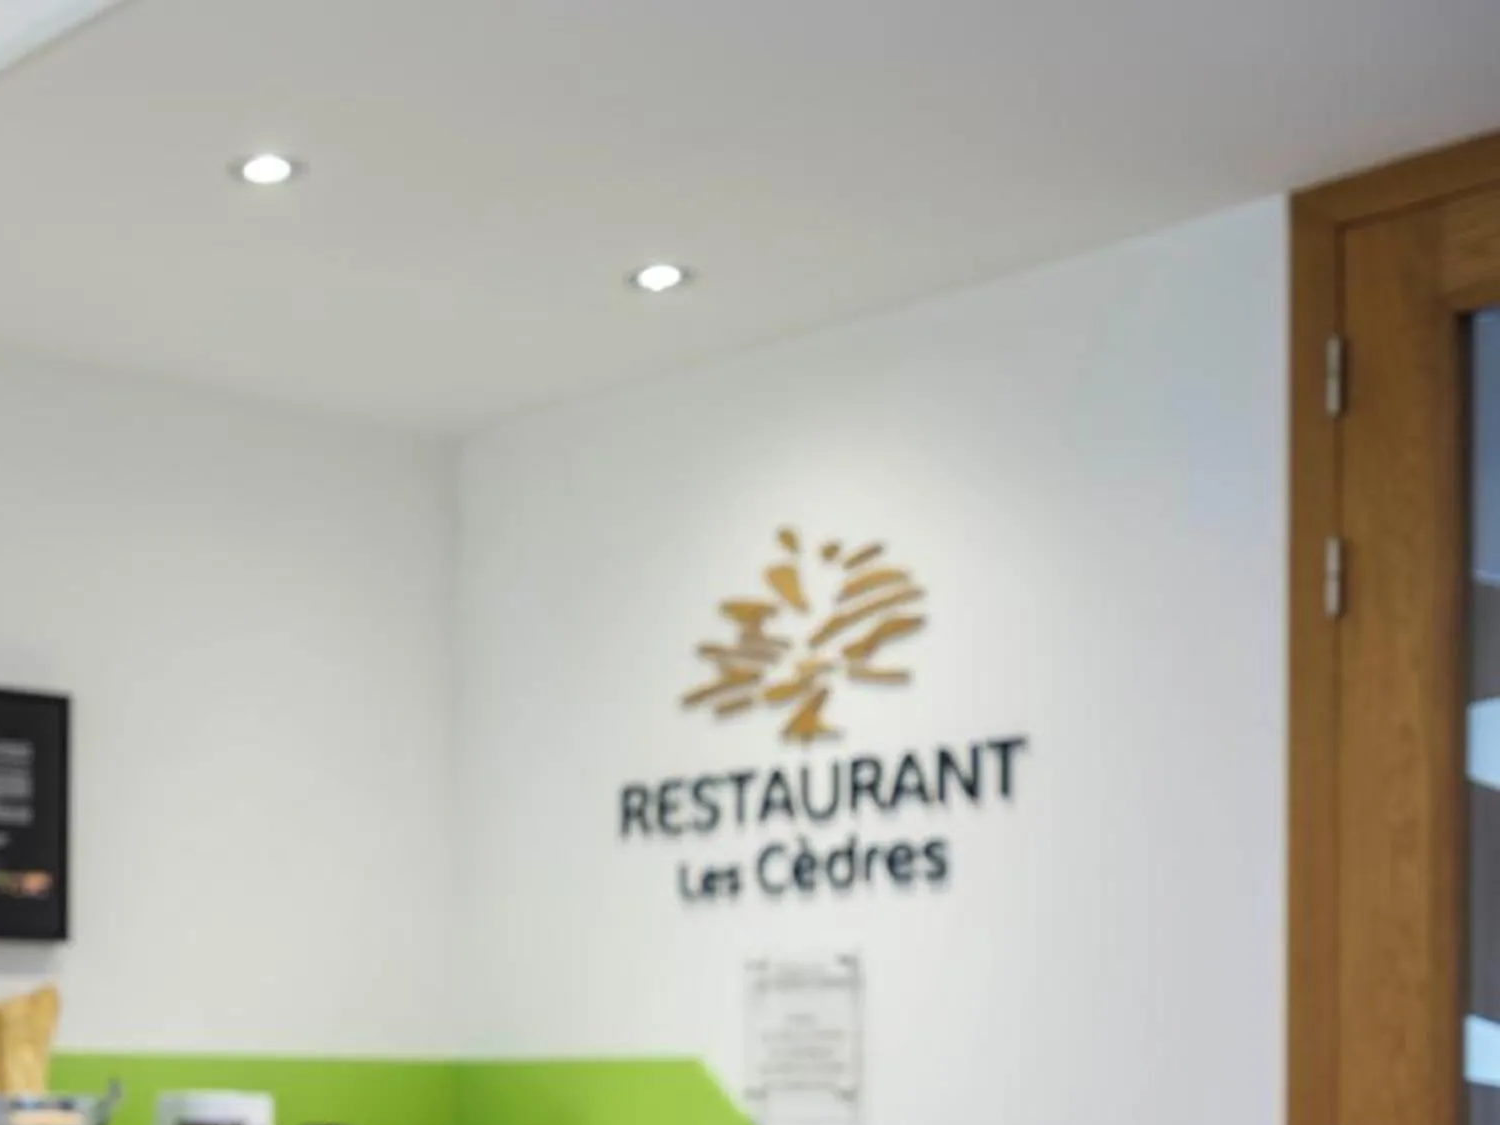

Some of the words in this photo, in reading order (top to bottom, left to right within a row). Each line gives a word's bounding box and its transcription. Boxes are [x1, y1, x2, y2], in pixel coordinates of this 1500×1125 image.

[619, 737, 1026, 836] RESTAURANT
[678, 864, 741, 901] Les
[757, 833, 948, 894] Cèdres
